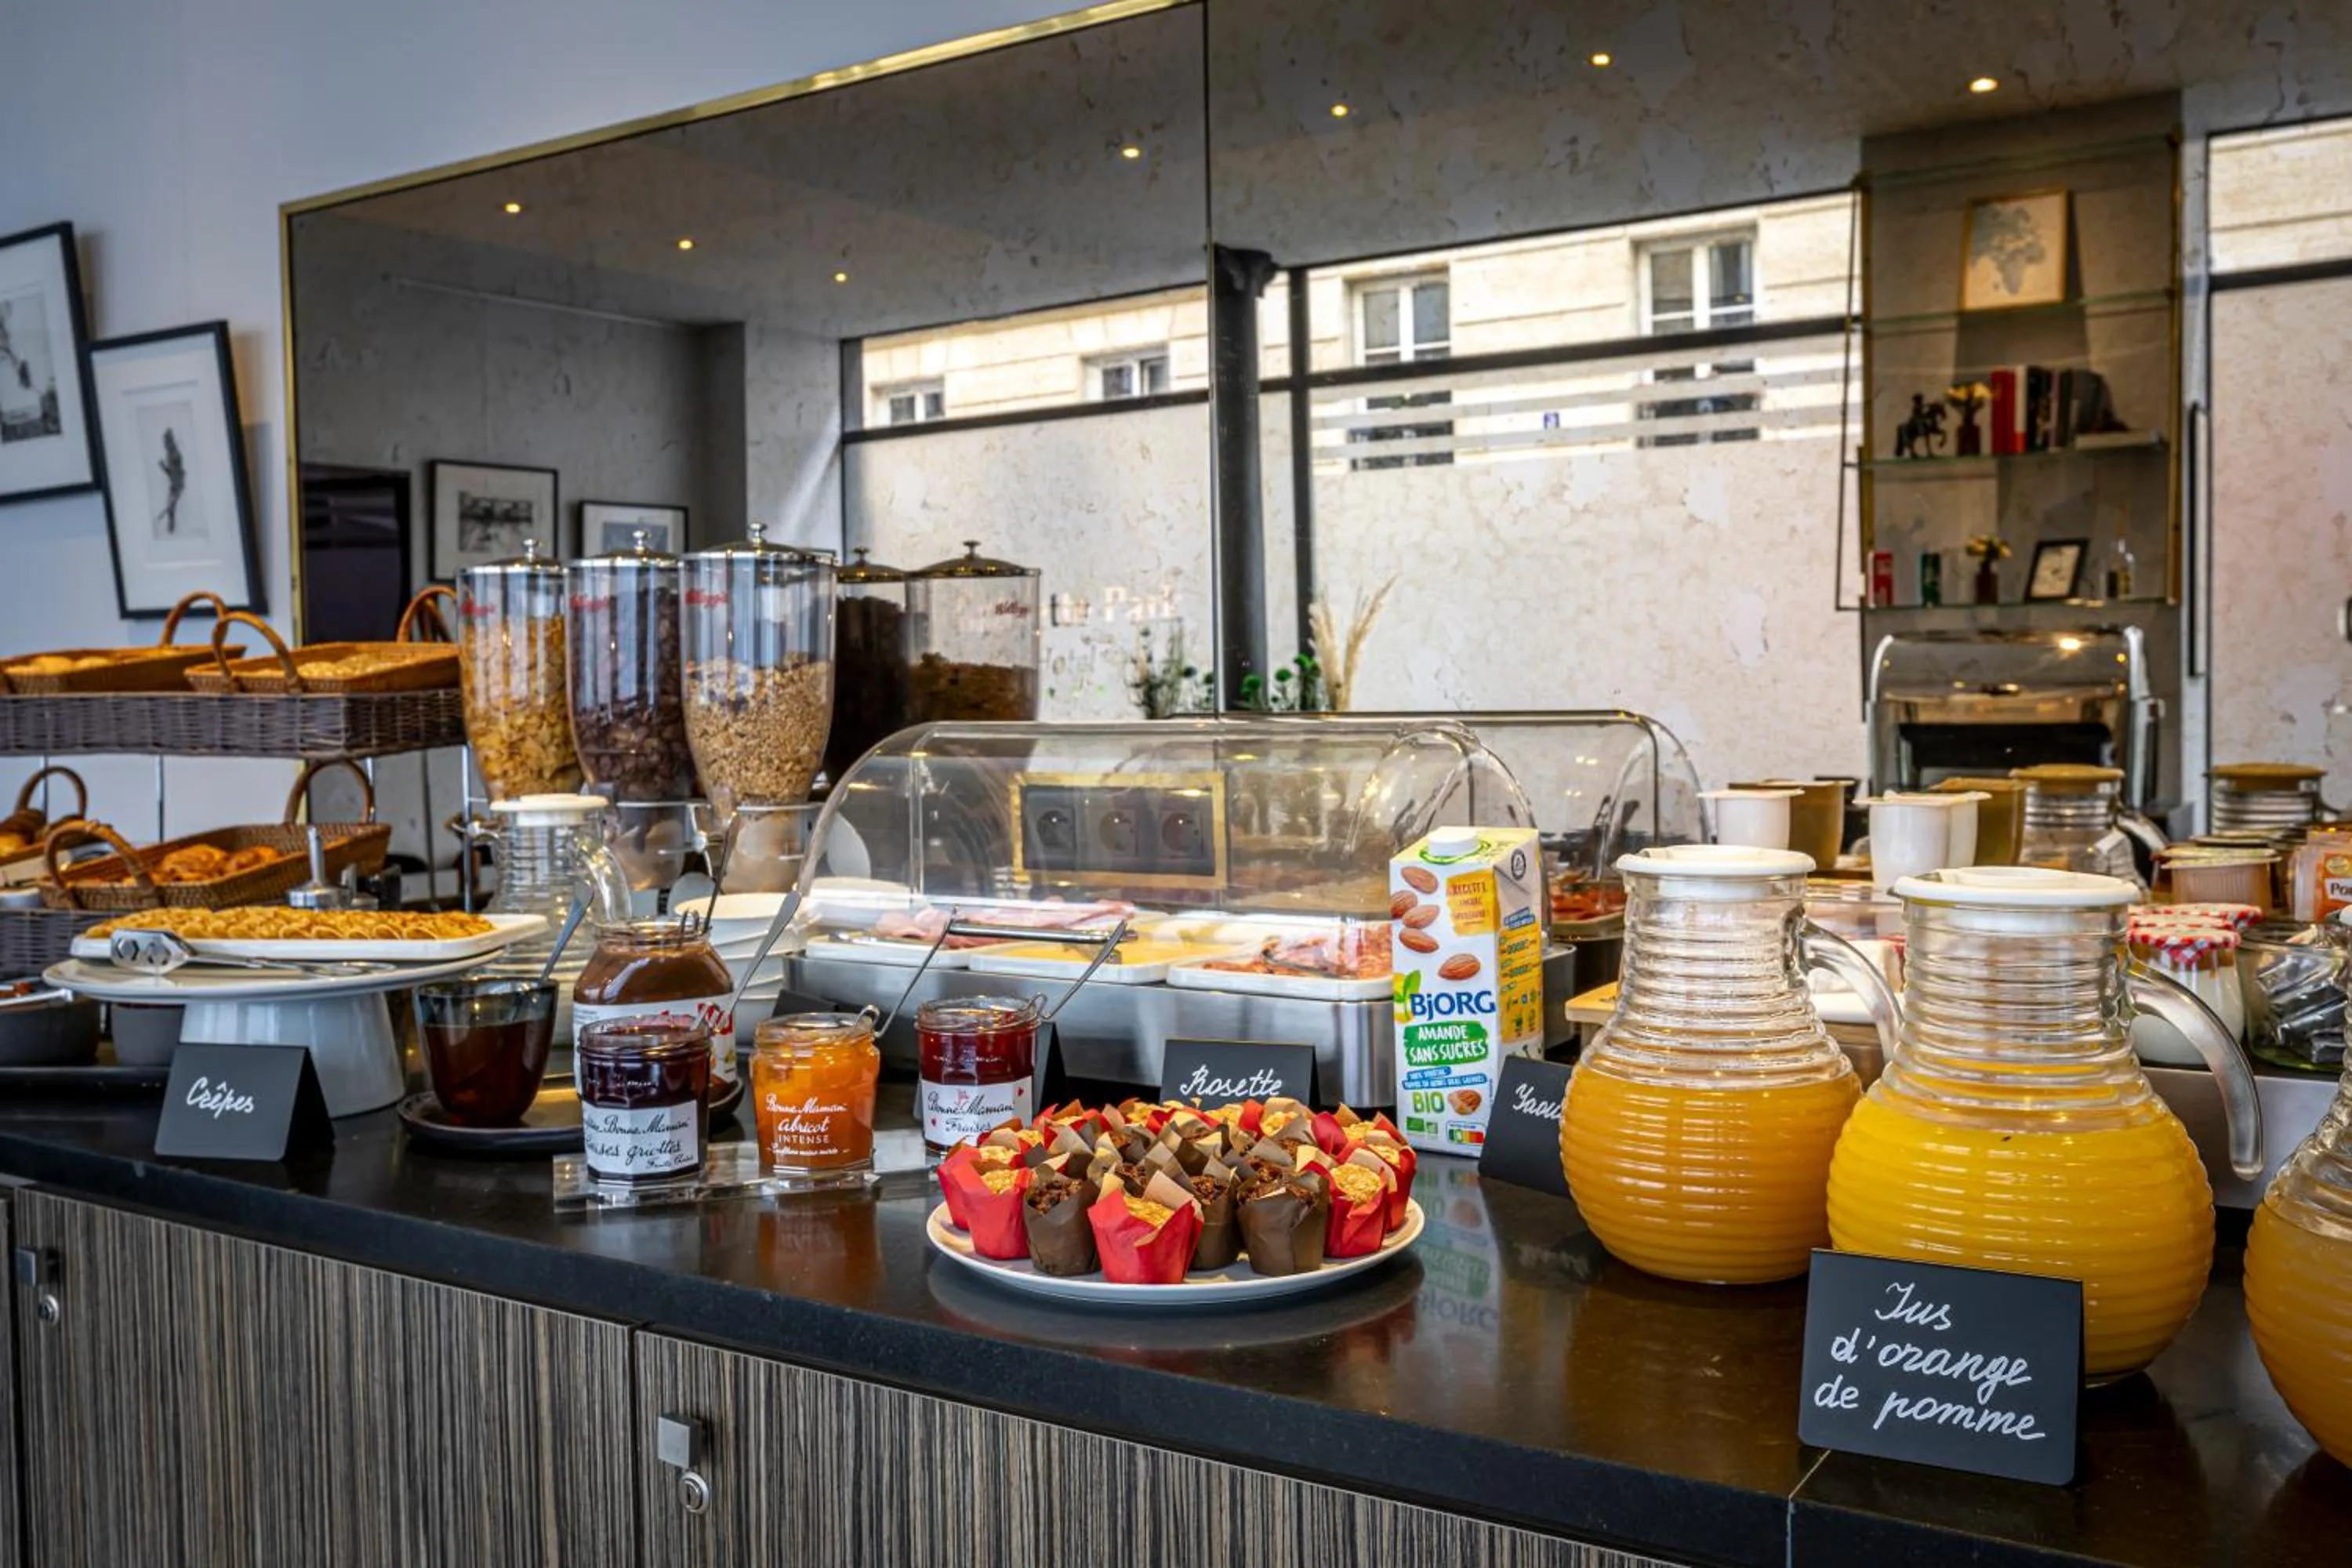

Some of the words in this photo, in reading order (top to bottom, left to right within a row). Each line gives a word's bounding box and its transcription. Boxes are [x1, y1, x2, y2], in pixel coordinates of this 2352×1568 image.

[1417, 1024, 1468, 1042] AMANDE
[1409, 1044, 1439, 1063] SANS
[1439, 1038, 1486, 1061] SUCRES
[1179, 1064, 1283, 1097] Rosette
[187, 1076, 255, 1119] Crêpes
[927, 1091, 960, 1115] Bonne
[963, 1093, 1015, 1116] Maman
[1412, 1091, 1445, 1113] BIO
[601, 1113, 641, 1134] Bonne
[642, 1112, 691, 1134] Maman
[778, 1134, 829, 1145] INTENSE
[625, 1140, 681, 1166] griottes
[1875, 1282, 1951, 1330] Jus
[1831, 1327, 2033, 1405] d'orange
[1813, 1374, 1860, 1409] de
[1872, 1391, 2046, 1441] pomme
